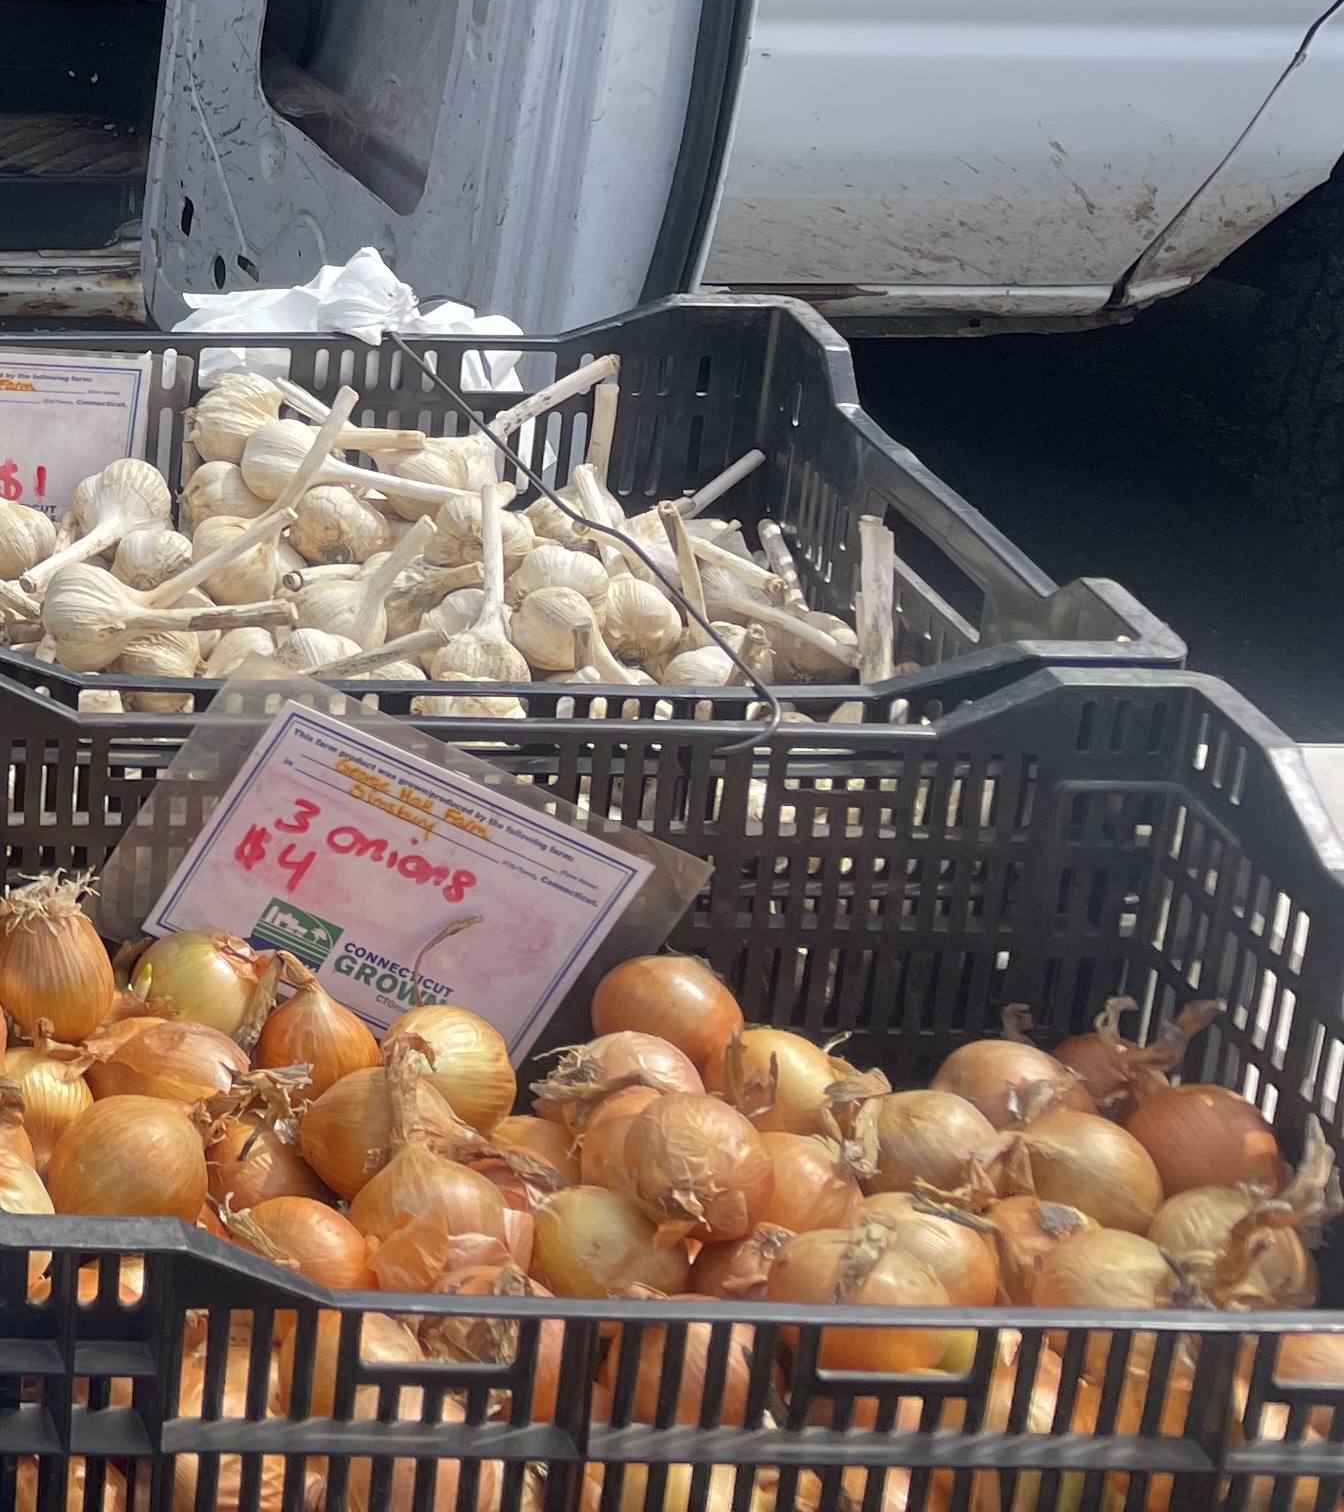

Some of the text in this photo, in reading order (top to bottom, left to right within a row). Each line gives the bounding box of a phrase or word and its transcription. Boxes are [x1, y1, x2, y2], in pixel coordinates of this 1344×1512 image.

[32, 374, 70, 383] following
[76, 399, 127, 408] Connecticut.
[273, 798, 321, 834] 3
[294, 727, 576, 863] This farm product was grown/produced by the following farm:
[335, 757, 390, 794] George
[399, 787, 435, 813] Hall
[443, 807, 492, 843] Farm
[283, 756, 294, 767] in
[541, 875, 599, 908] Connecticut.
[344, 941, 455, 999] CONNECTICUT
